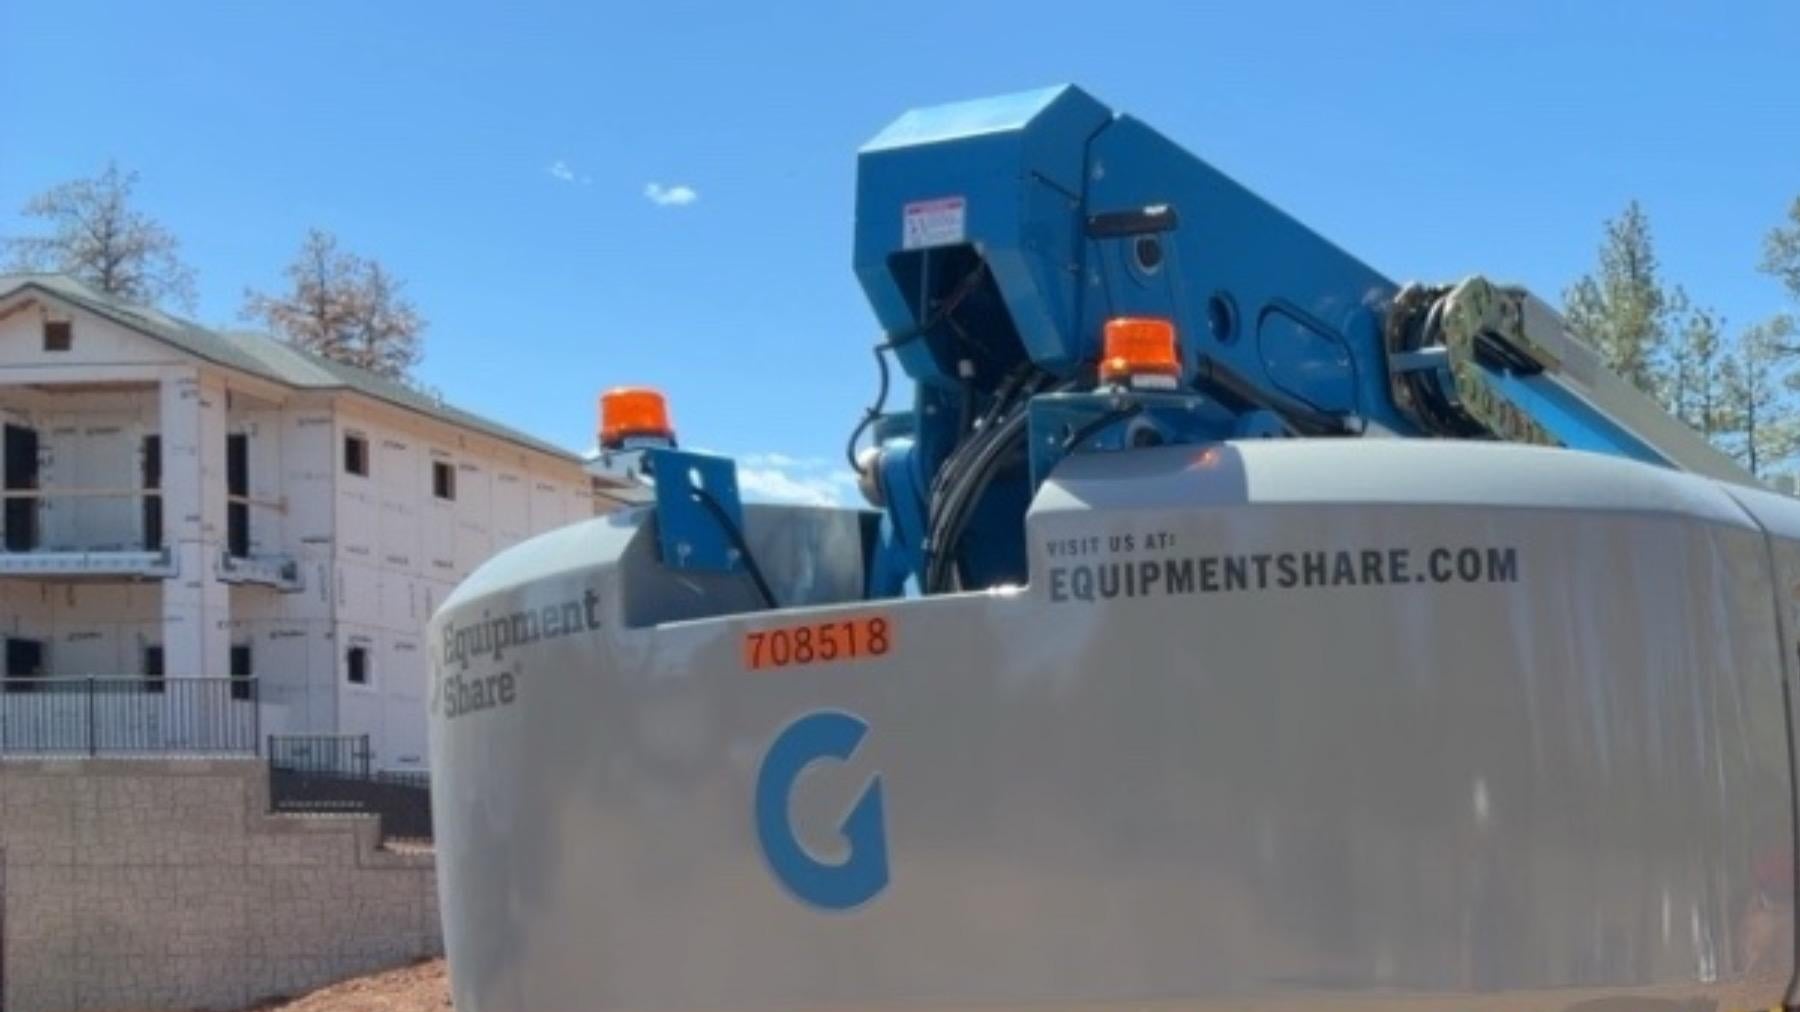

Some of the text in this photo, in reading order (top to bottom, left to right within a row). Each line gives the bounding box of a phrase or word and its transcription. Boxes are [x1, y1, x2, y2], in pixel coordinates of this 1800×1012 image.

[1047, 535, 1100, 556] VISIT
[1109, 533, 1135, 553] US
[1050, 546, 1519, 603] EQUIPMENTSHARE.COM
[442, 588, 602, 669] Equipment
[746, 617, 889, 669] 708518
[443, 672, 516, 720] Share
